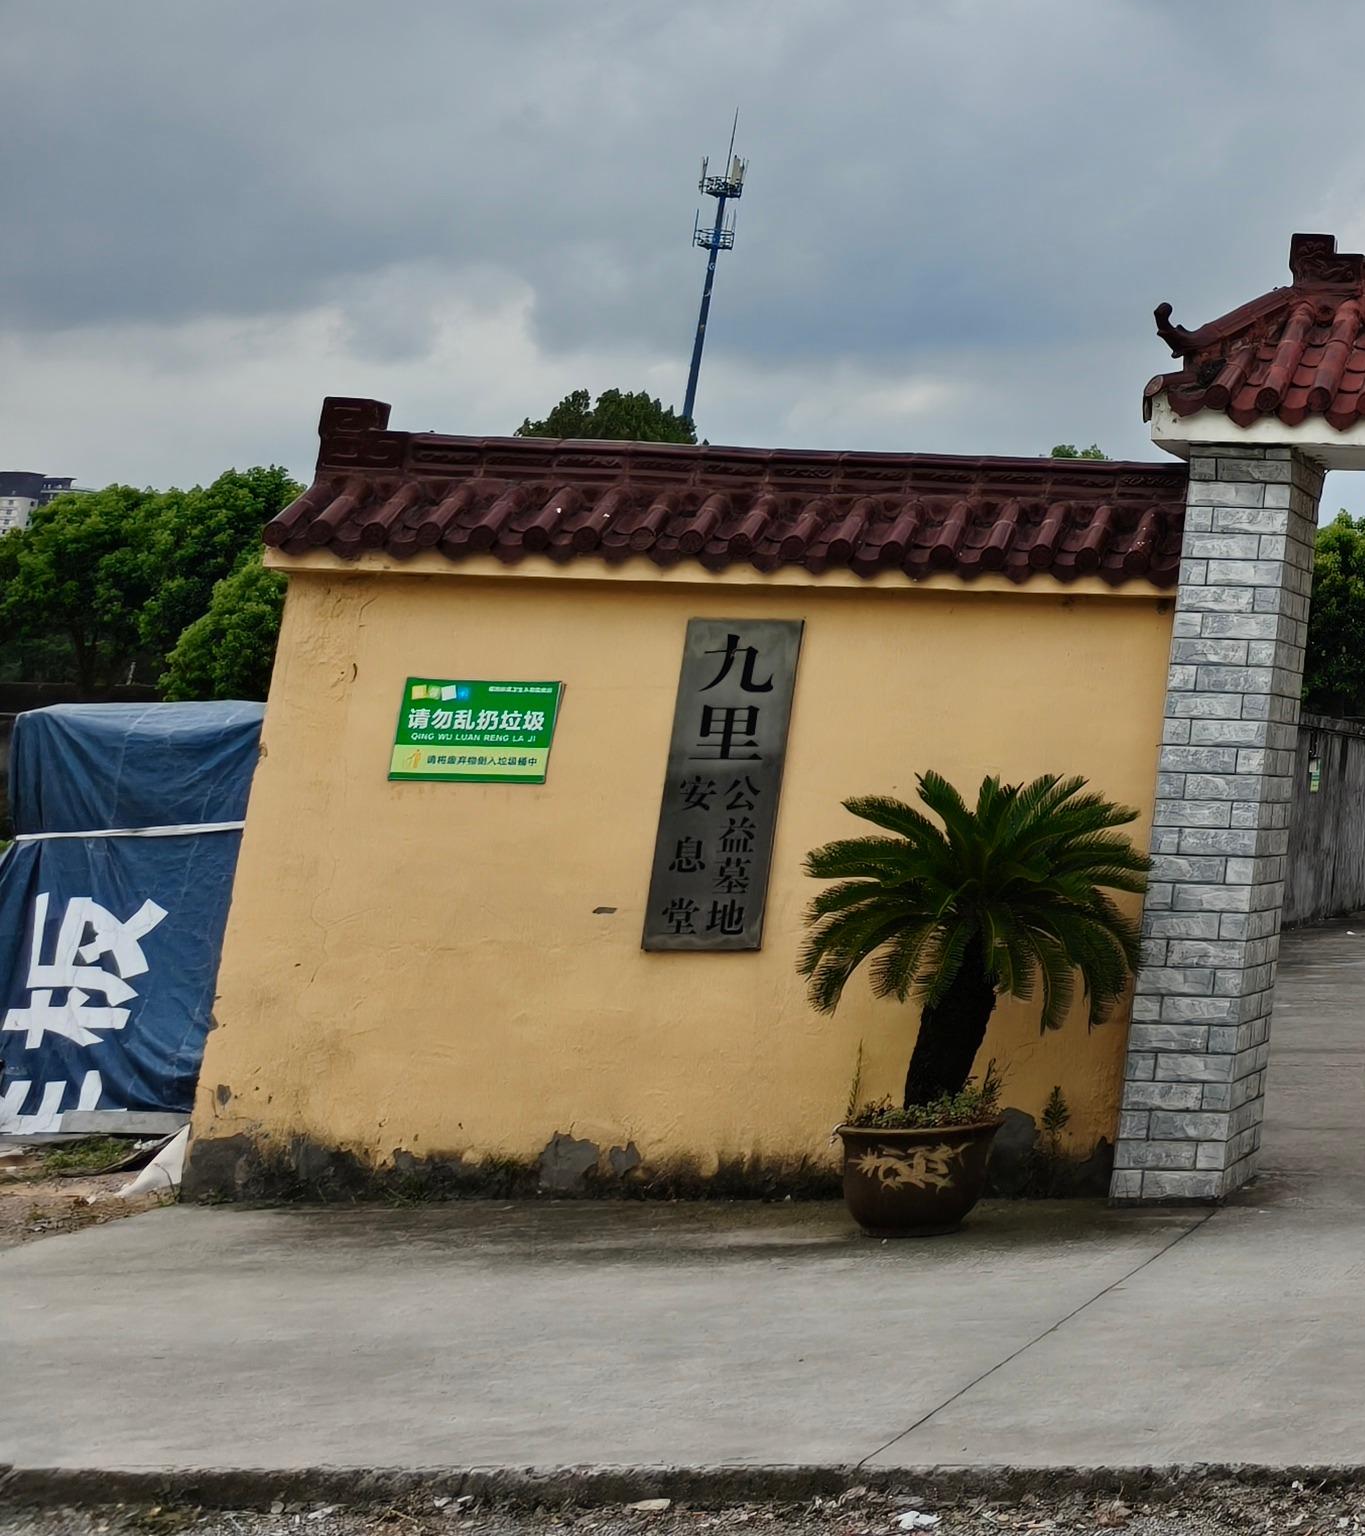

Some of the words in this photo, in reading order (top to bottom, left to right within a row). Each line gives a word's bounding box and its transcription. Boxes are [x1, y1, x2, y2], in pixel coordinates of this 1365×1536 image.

[408, 708, 545, 731] 请勿乱扔垃圾
[411, 732, 435, 741] QING
[438, 733, 453, 741] WU
[483, 734, 509, 742] RENG
[688, 633, 774, 761] 九里
[661, 775, 717, 935] 安息堂
[706, 775, 761, 936] 公益墓地
